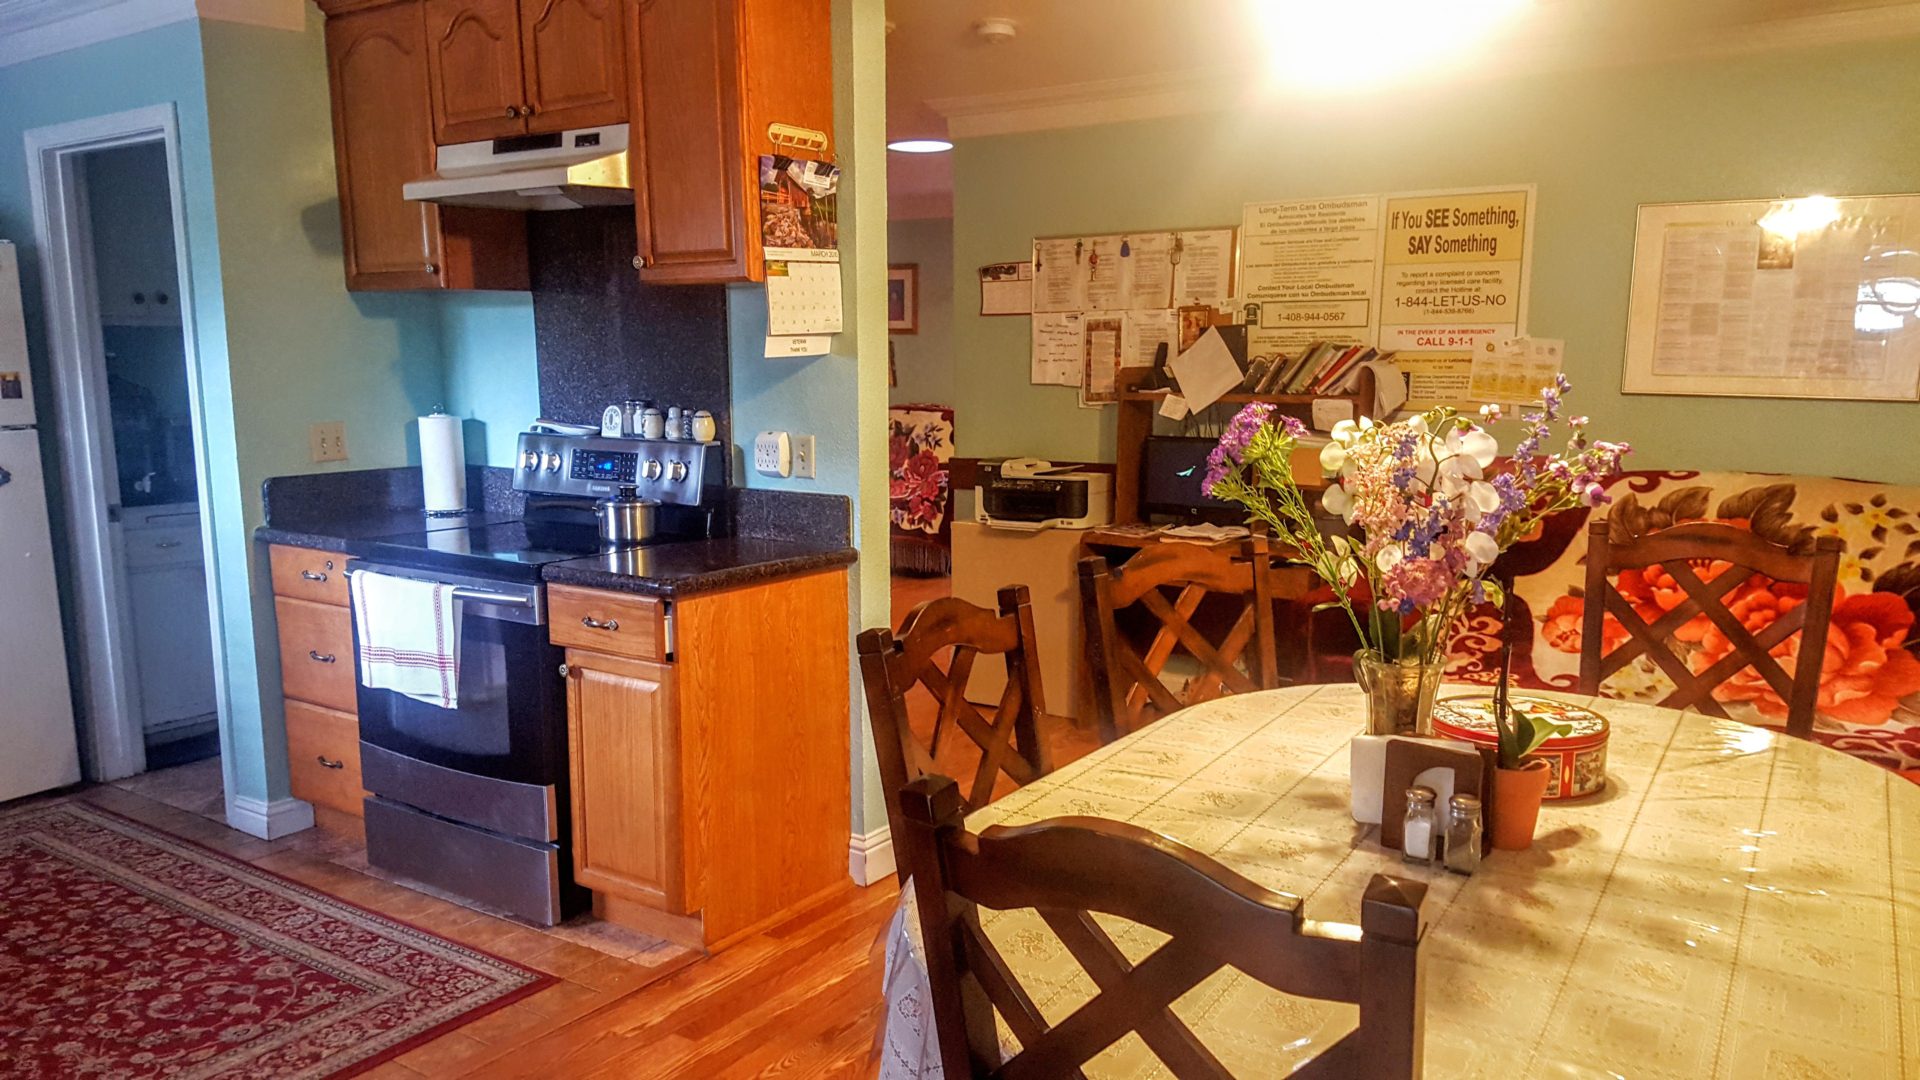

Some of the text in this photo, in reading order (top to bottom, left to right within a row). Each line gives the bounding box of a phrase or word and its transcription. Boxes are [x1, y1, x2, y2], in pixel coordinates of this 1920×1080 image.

[1259, 205, 1297, 214] Long-Term
[1318, 201, 1368, 210] Ombudsman
[1391, 205, 1520, 230] If You SEE Something,
[1408, 233, 1498, 256] SAY Something
[1410, 271, 1428, 280] report
[1436, 270, 1465, 278] complaint
[1310, 290, 1350, 298] Ombudsman
[1395, 294, 1507, 308] 1-844-LET-US-NO
[1278, 312, 1346, 322] 1-408-944-0567
[1416, 337, 1474, 346] CALL 9-1-1
